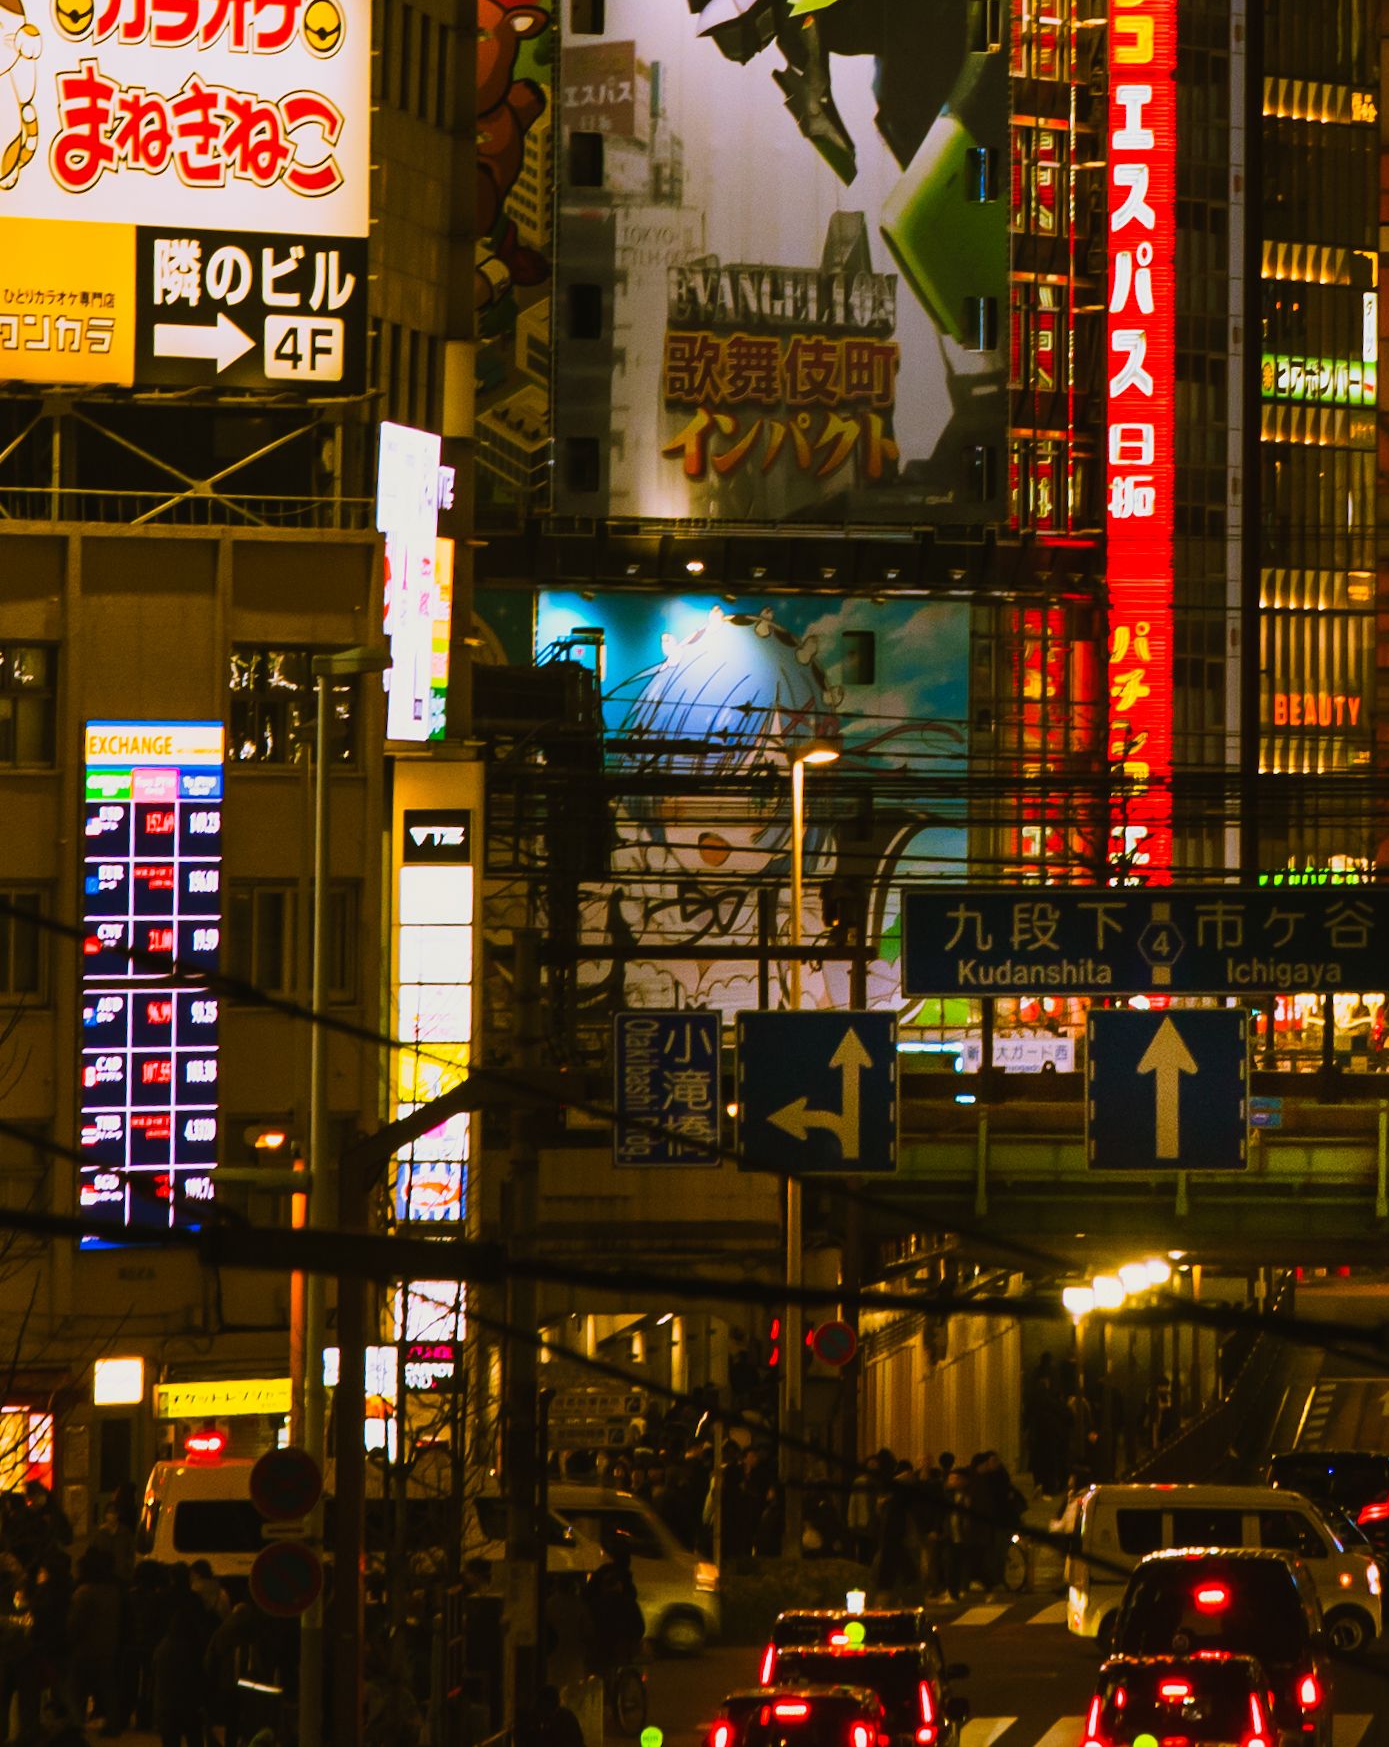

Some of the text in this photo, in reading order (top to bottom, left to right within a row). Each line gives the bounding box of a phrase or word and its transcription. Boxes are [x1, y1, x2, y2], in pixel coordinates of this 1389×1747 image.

[51, 61, 344, 195] まねきねこ
[1109, 85, 1157, 399] エスパス
[4, 288, 115, 309] ひとりカラオケ専門店
[153, 238, 356, 312] 隣のビル
[667, 266, 898, 328] EVANGELION
[273, 326, 334, 371] 4F
[667, 332, 899, 406] 歌舞伎町
[662, 407, 900, 479] インパクト
[1107, 422, 1155, 519] 日拓
[1273, 694, 1361, 727] BEAUTY
[89, 735, 173, 755] EXCHANGE
[945, 901, 1127, 951] 九段下
[1154, 931, 1171, 956] 4
[957, 959, 1113, 986] Kudanshita
[1226, 956, 1341, 989] Ichigaya
[624, 1019, 660, 1111] Otakibashi
